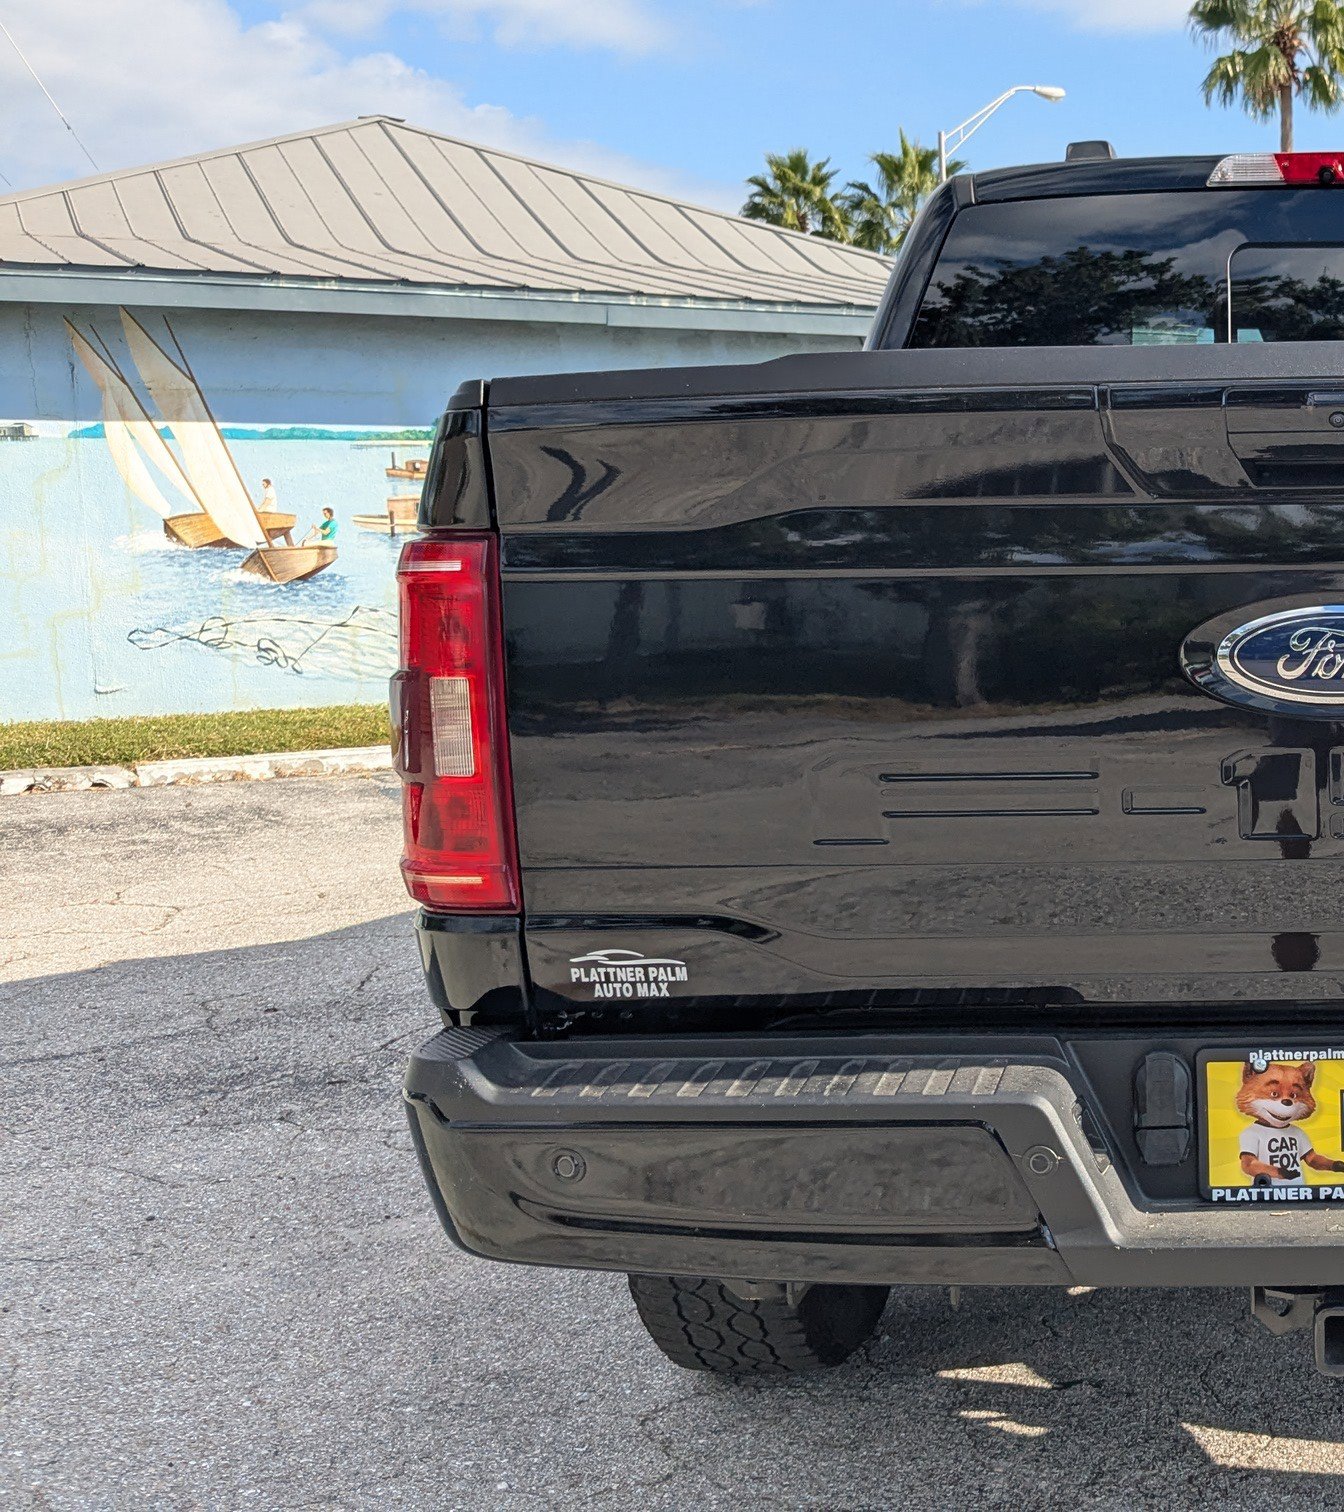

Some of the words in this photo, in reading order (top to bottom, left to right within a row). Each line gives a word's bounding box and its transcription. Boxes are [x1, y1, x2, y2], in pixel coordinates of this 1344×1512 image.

[570, 967, 646, 983] PLATTNER
[648, 966, 689, 982] PALM
[594, 983, 633, 998] AUTO
[636, 982, 670, 997] MAX
[1267, 1136, 1298, 1153] CAR
[1269, 1152, 1300, 1169] FOX
[1212, 1186, 1313, 1201] PLATTNER
